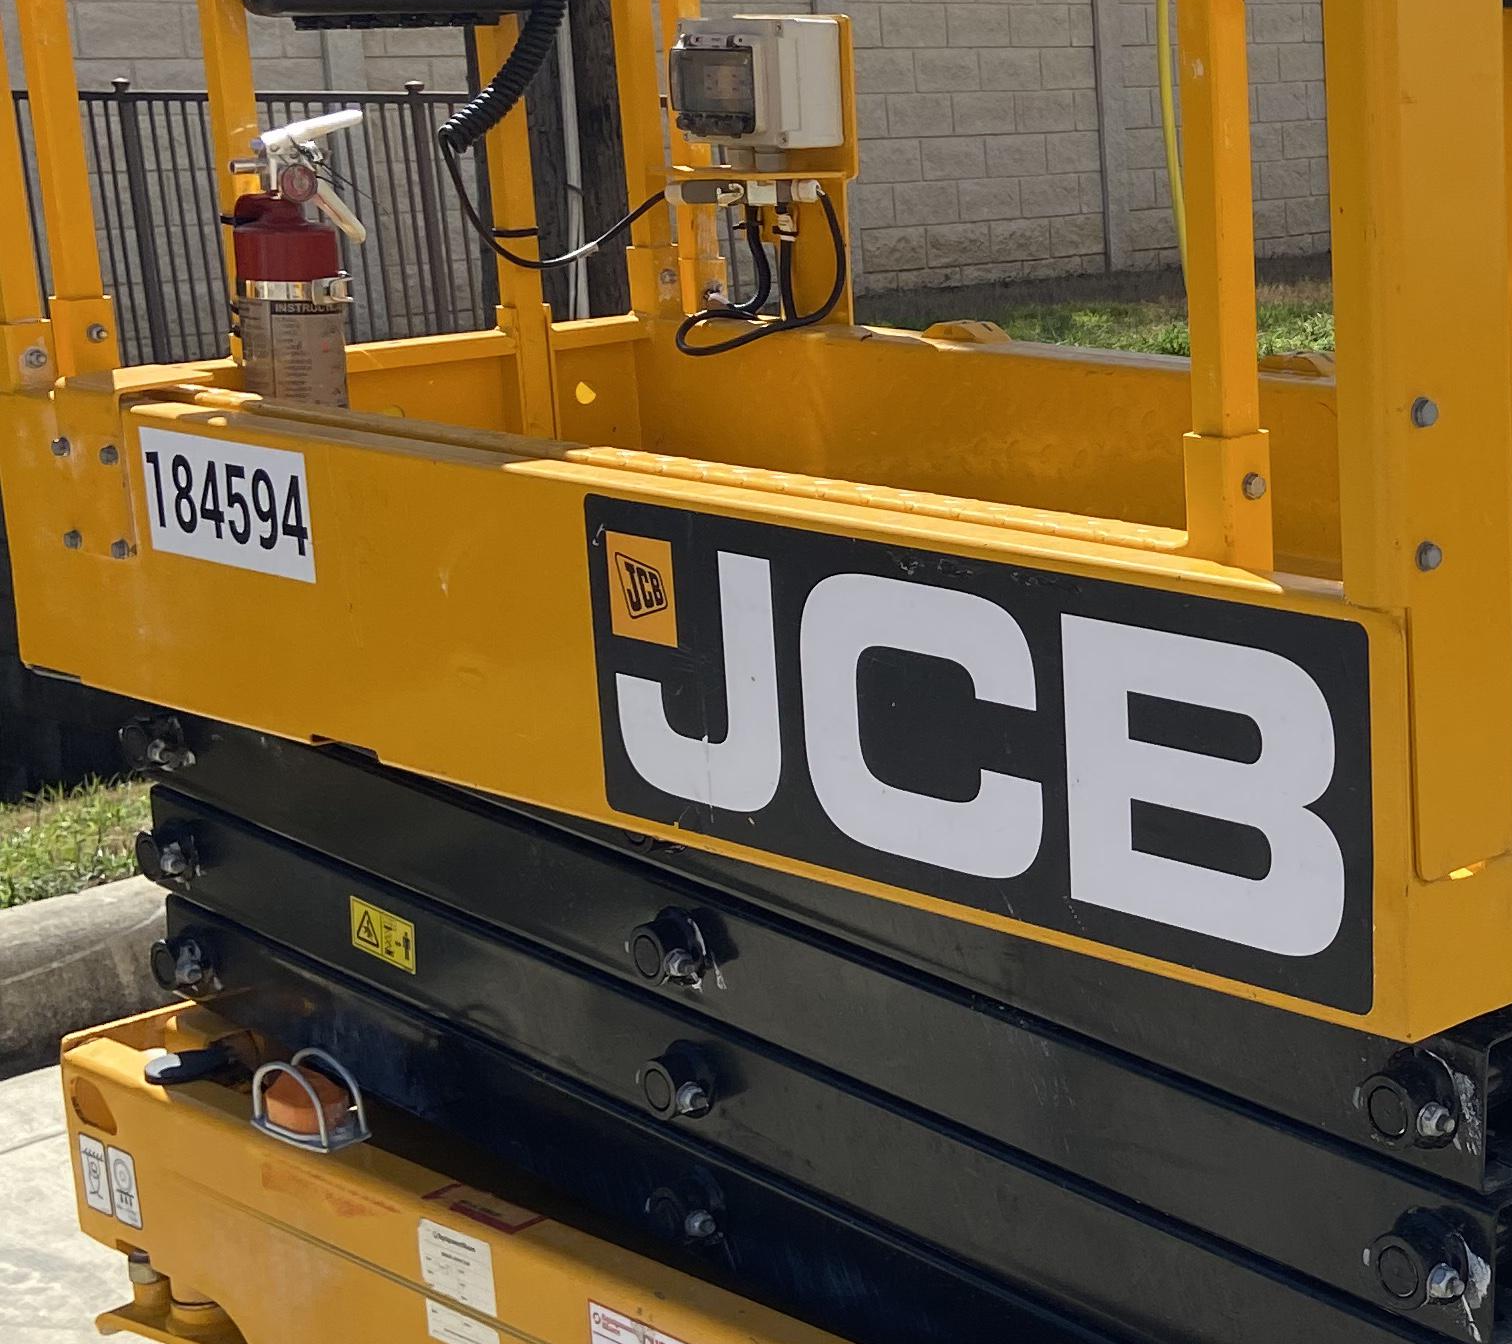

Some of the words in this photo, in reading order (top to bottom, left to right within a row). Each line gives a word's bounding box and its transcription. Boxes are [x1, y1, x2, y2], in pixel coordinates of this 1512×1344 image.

[145, 451, 309, 556] 184594
[623, 560, 666, 614] JCB
[616, 550, 1346, 958] JCB
